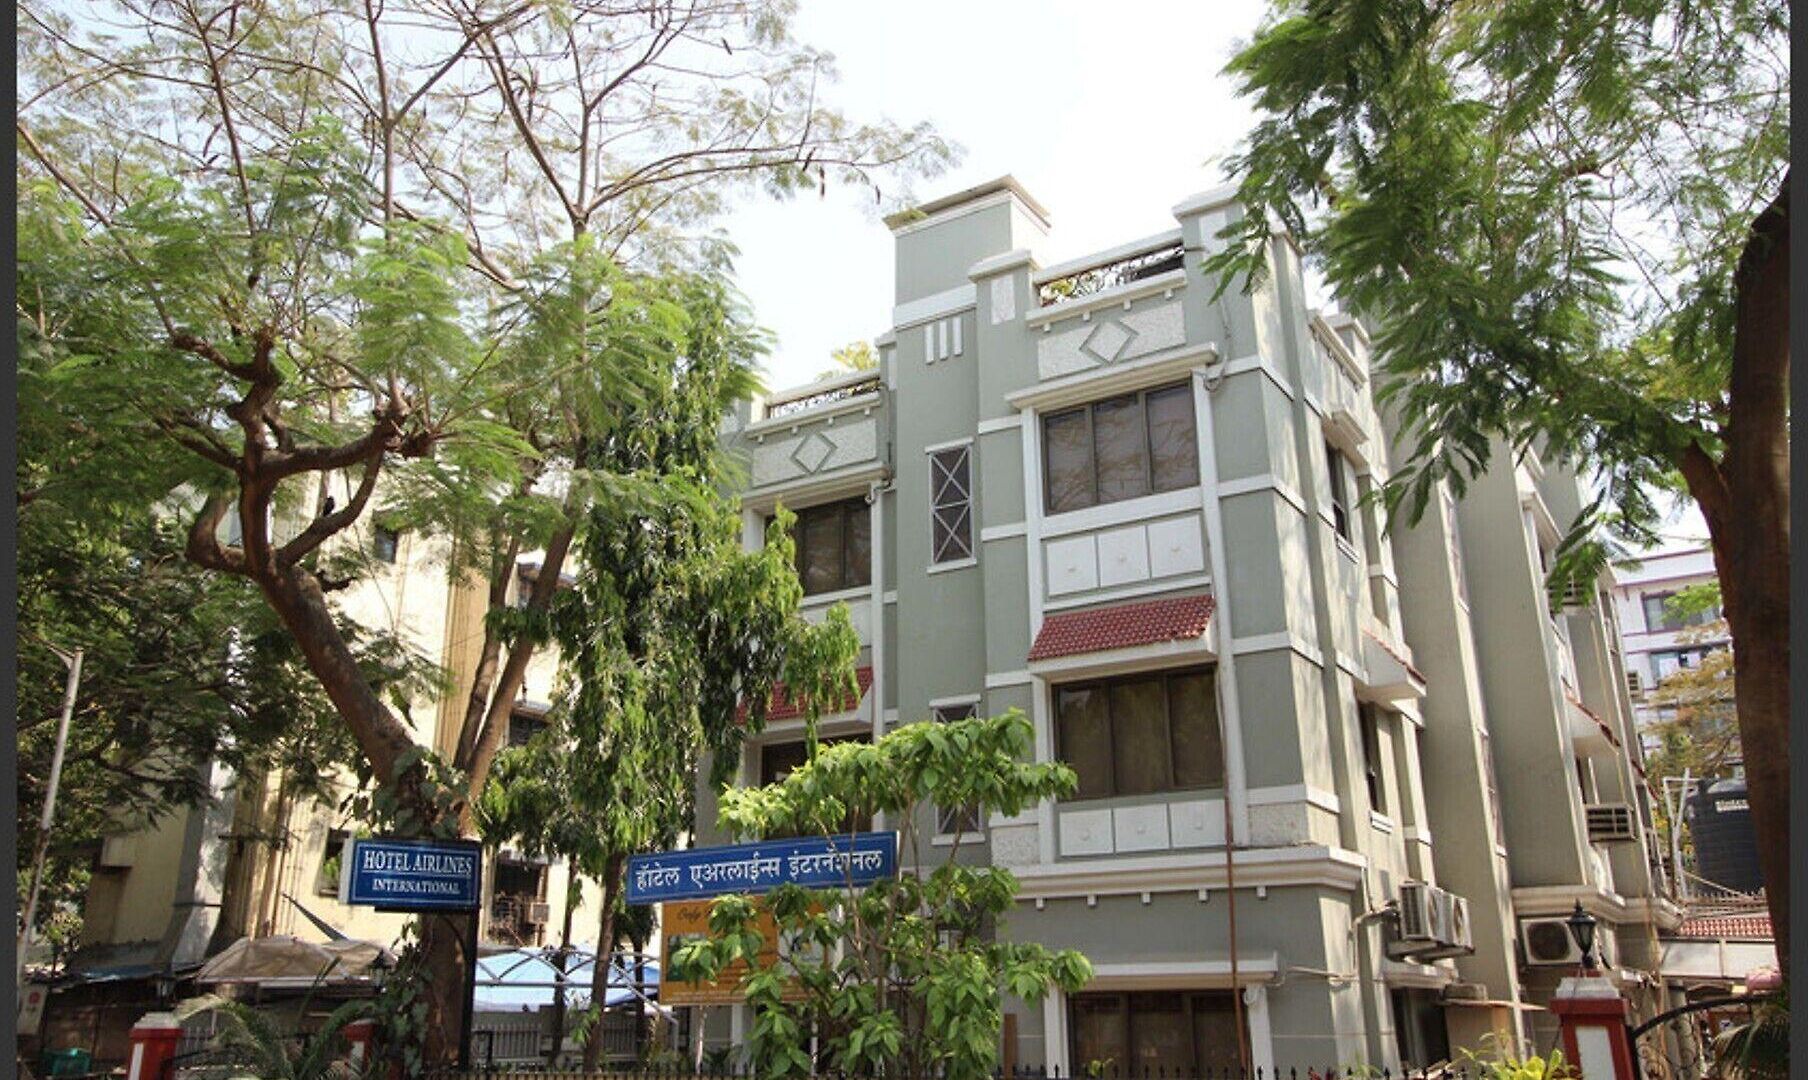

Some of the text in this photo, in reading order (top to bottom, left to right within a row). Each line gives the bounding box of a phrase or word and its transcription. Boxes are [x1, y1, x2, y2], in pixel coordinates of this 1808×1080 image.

[363, 850, 472, 874] HOTEL AIRLINES
[372, 878, 460, 894] INTERNATIONAL
[635, 861, 681, 892] हॉटेल
